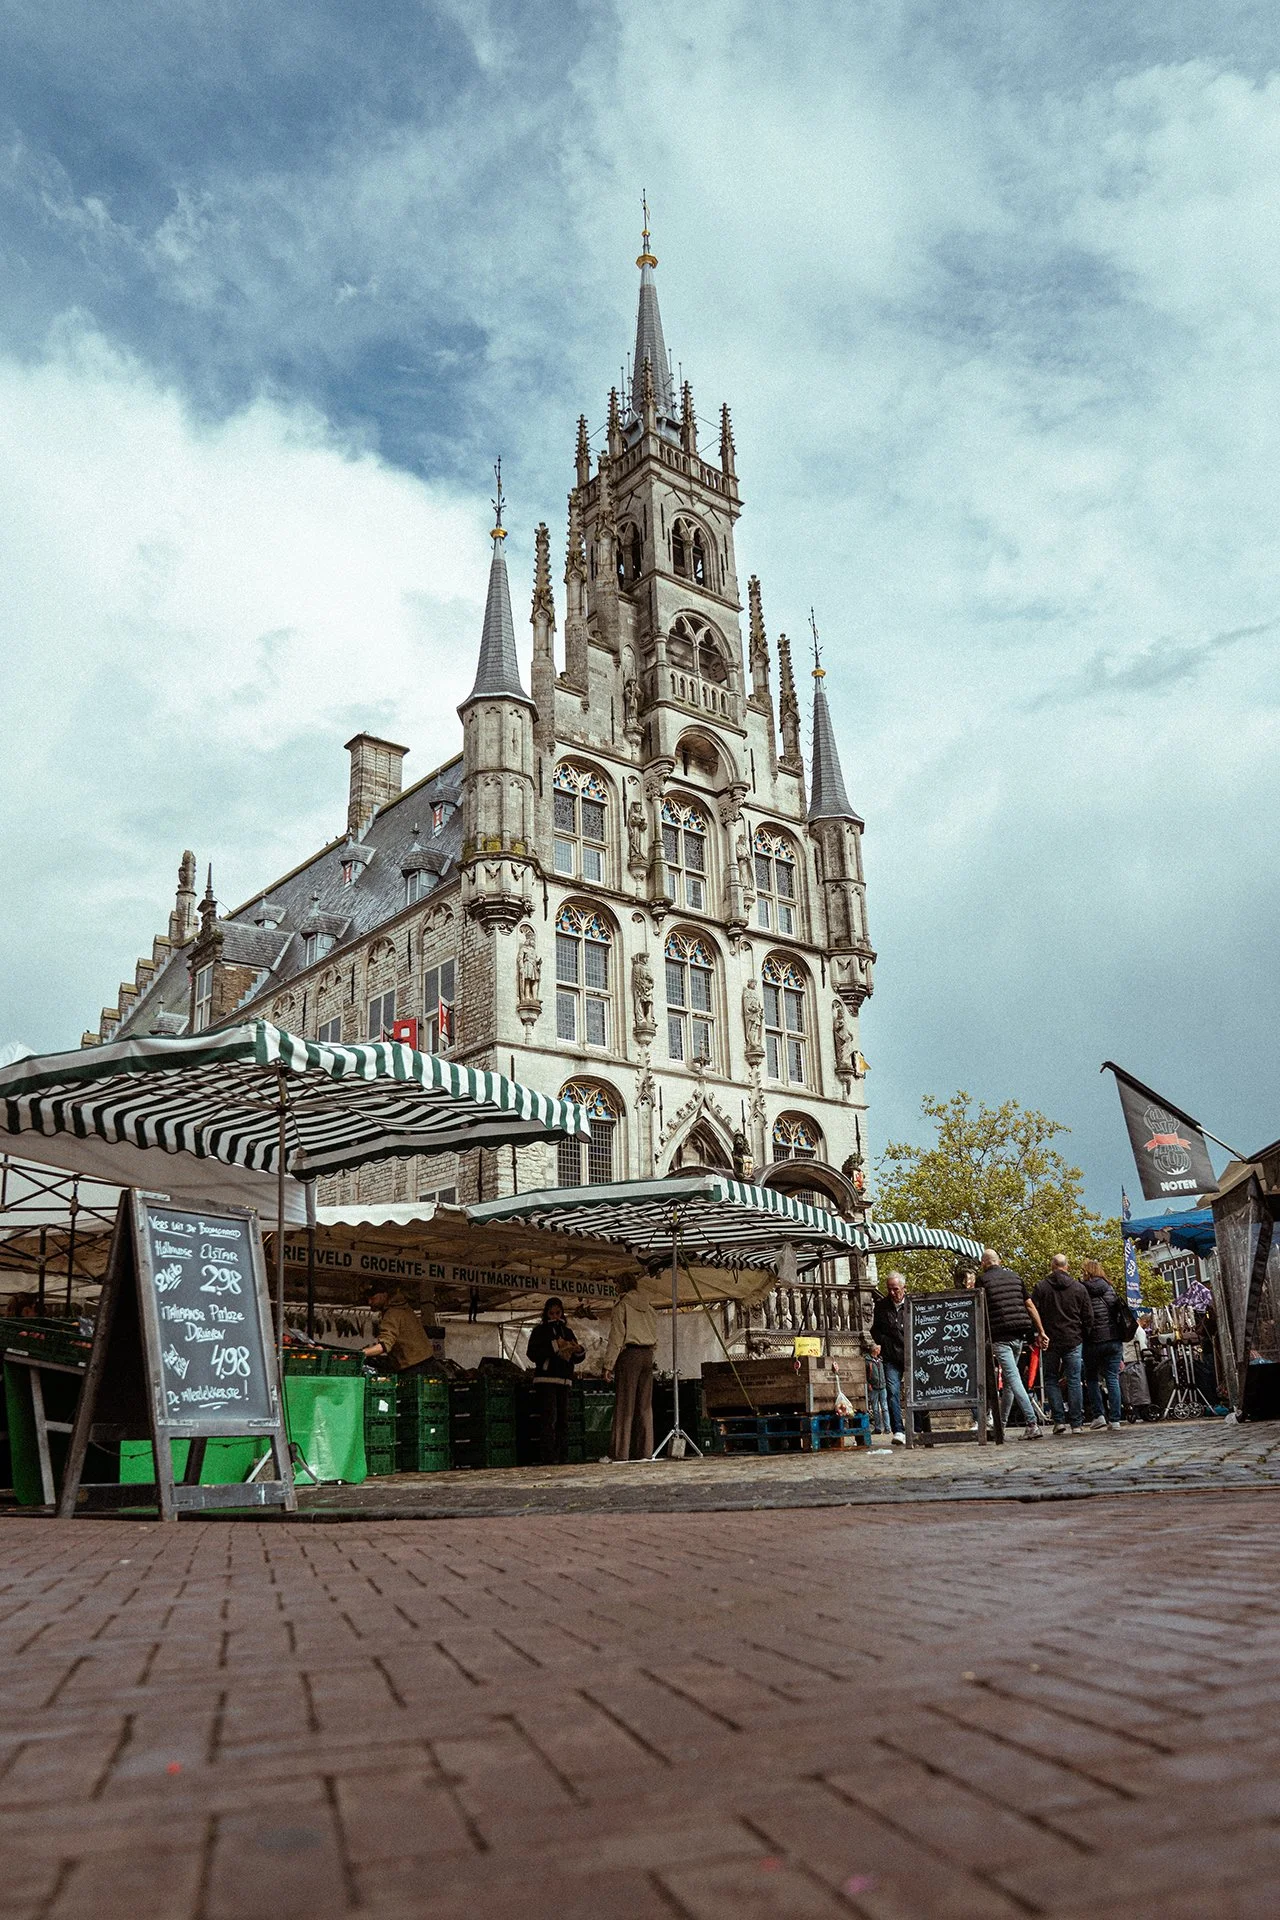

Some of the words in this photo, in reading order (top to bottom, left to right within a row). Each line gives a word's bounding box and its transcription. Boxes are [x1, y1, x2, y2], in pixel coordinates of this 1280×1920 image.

[1160, 1178, 1198, 1192] NOTEN
[283, 1244, 353, 1267] RIEVELD
[429, 1263, 446, 1279] EN
[452, 1267, 539, 1290] FRUITMARKTEN
[549, 1278, 575, 1293] ELKE
[576, 1282, 595, 1295] DAG
